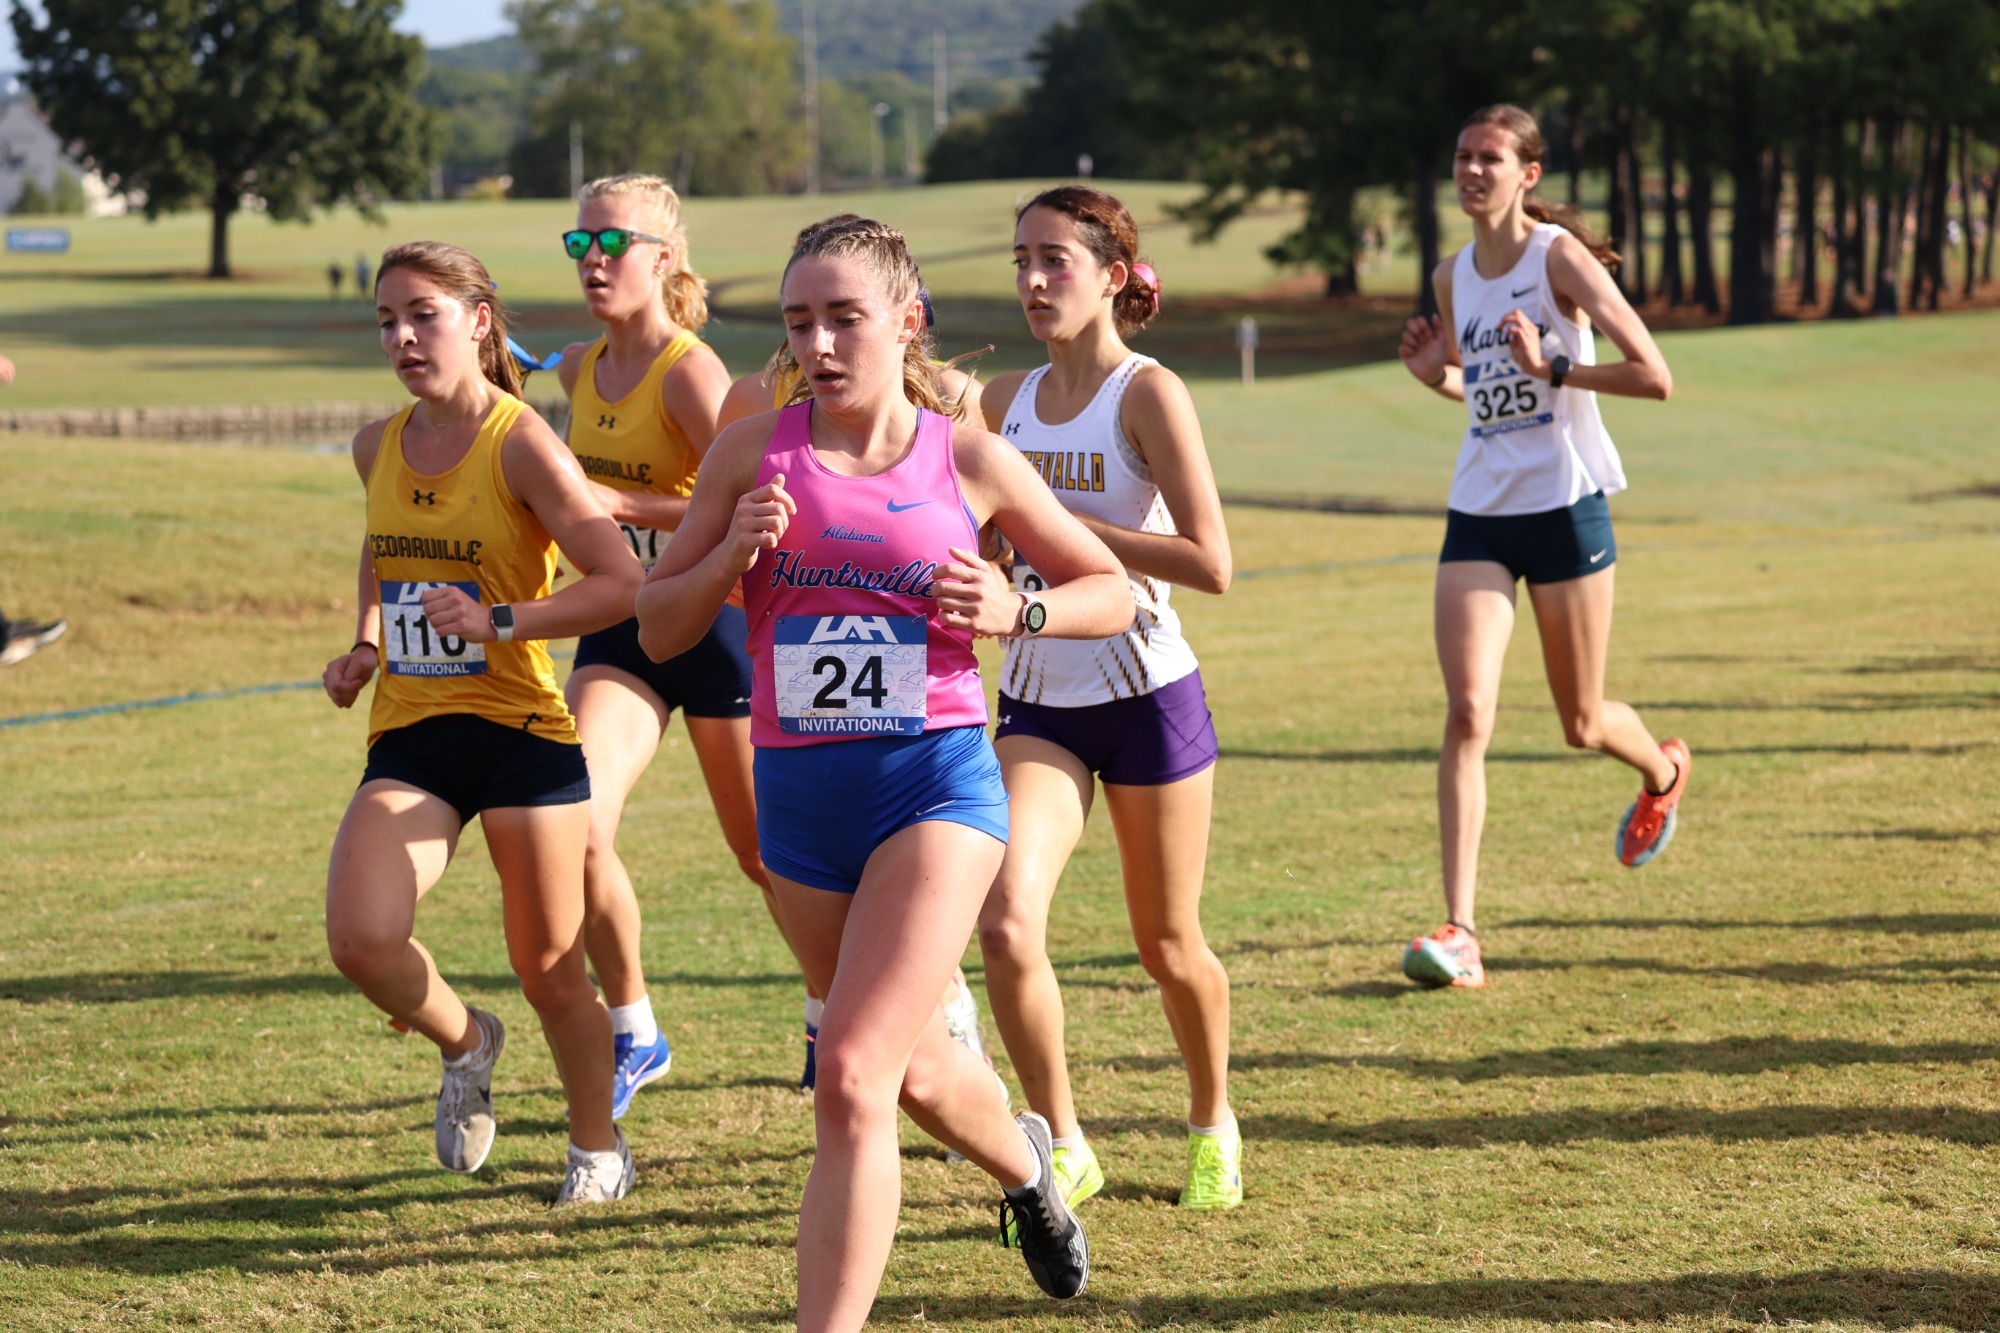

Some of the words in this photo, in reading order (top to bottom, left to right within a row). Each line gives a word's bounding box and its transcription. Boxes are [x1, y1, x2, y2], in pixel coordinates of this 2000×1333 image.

[1474, 379, 1538, 421] 325
[819, 525, 885, 543] Alabama
[370, 534, 482, 566] CEDARVILLE
[770, 550, 937, 599] Huntsville
[808, 616, 899, 644] UAH
[398, 662, 470, 675] INVITATIONAL
[812, 655, 888, 709] 24
[798, 718, 904, 733] INVITATIONAL
